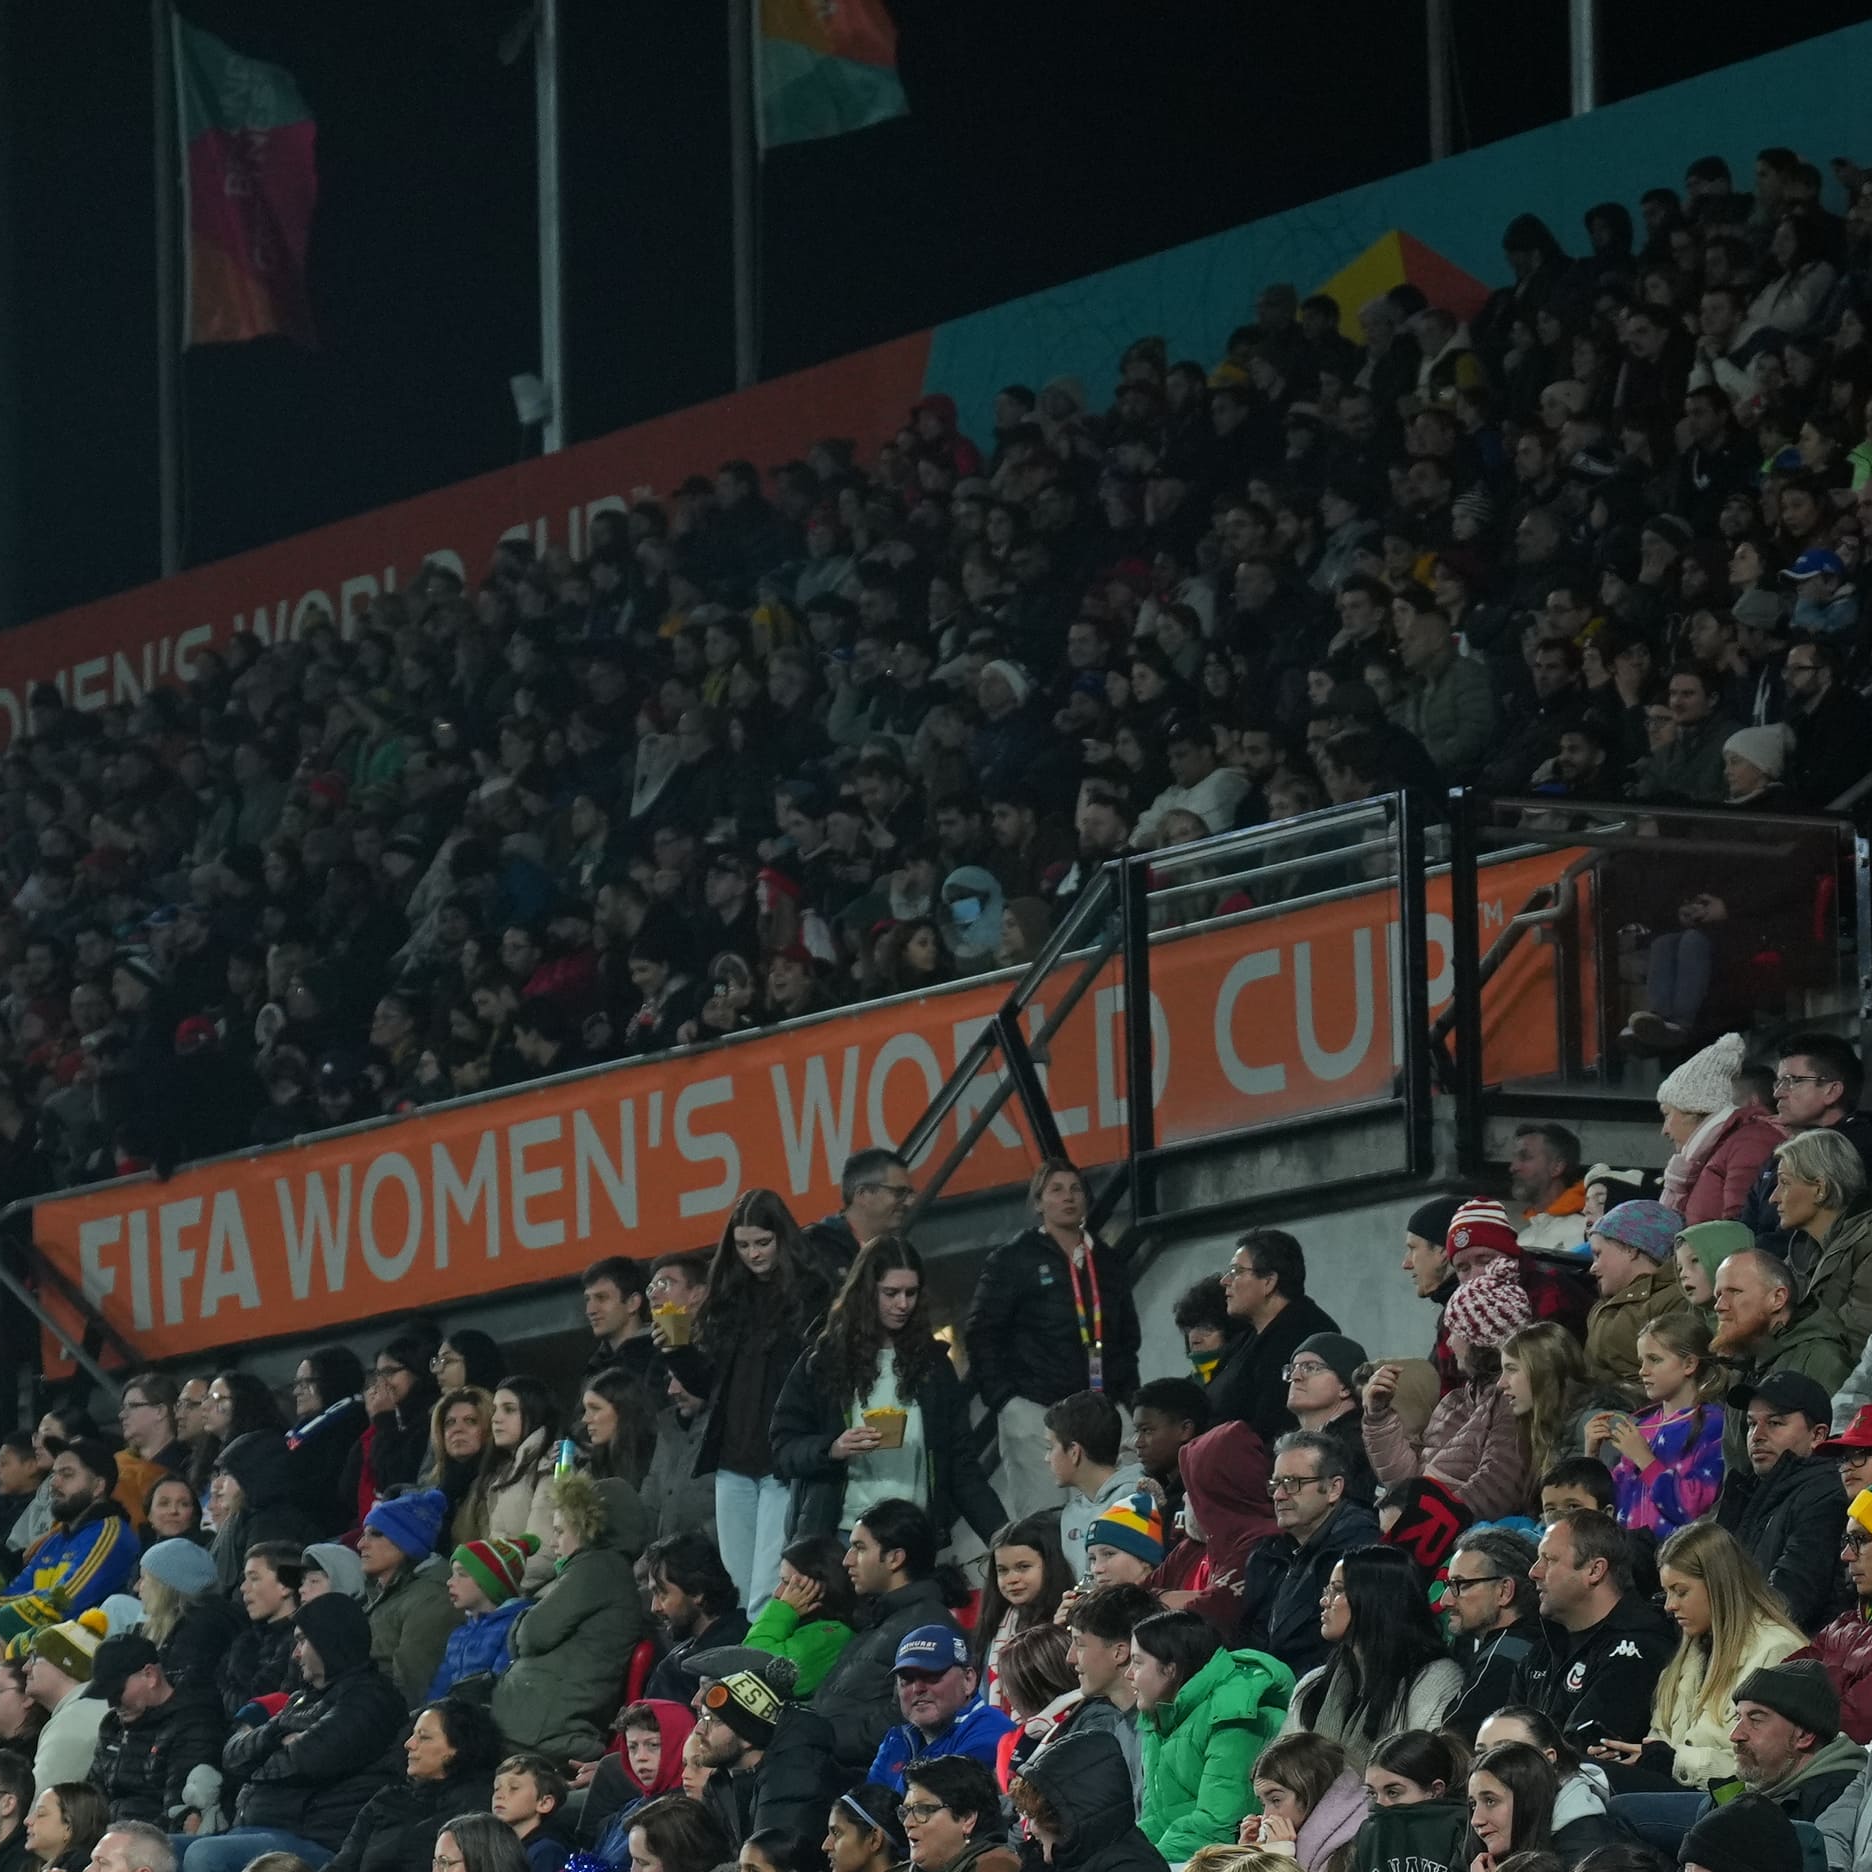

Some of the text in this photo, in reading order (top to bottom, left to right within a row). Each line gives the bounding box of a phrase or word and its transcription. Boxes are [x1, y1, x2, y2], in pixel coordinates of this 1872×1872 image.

[78, 1190, 261, 1336] FIFA
[274, 1076, 742, 1303] WOMEN'S
[771, 984, 1170, 1196] WORLD
[1212, 908, 1456, 1097] CUP
